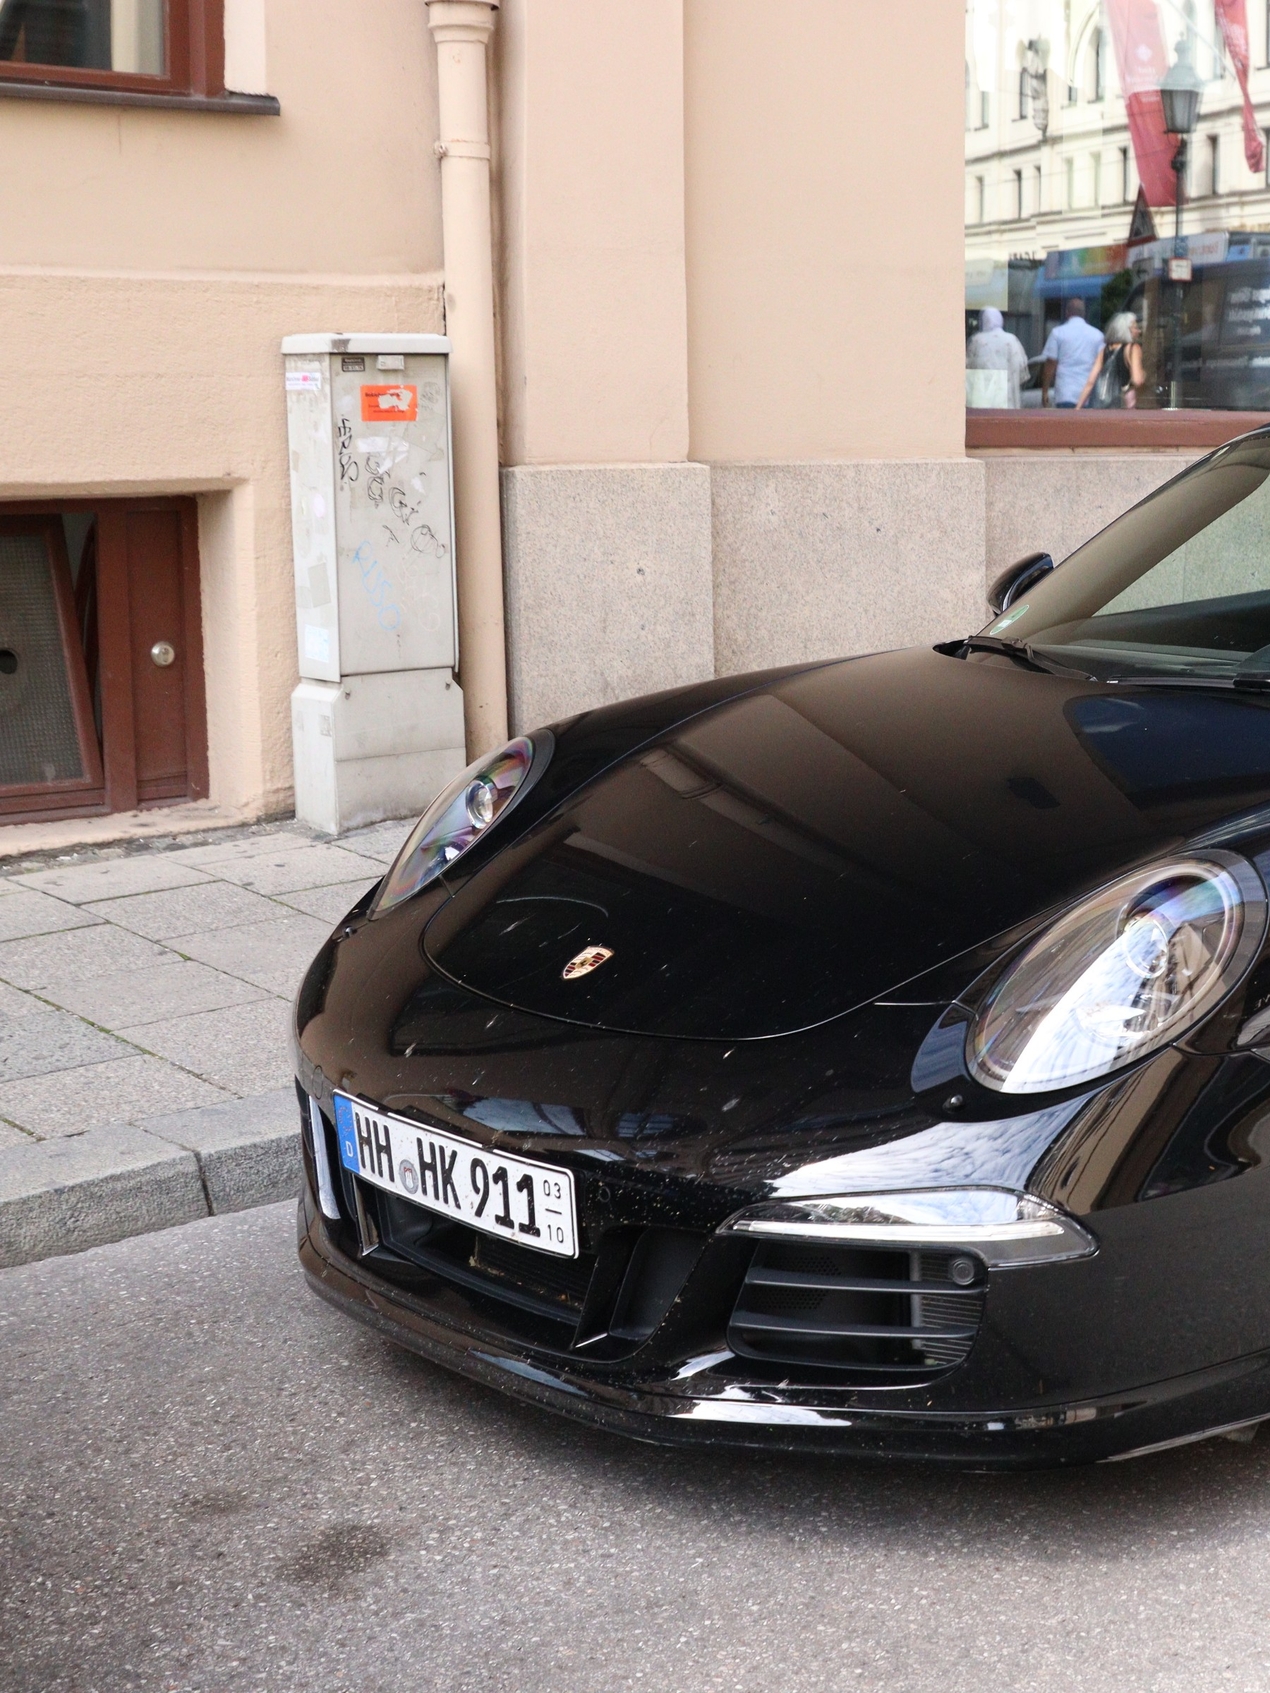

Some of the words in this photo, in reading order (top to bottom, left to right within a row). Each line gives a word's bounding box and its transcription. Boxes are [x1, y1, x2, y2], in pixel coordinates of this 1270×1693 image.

[345, 1141, 354, 1158] D
[355, 1112, 396, 1183] HH
[416, 1137, 462, 1210] HK
[470, 1157, 541, 1238] 911
[543, 1179, 562, 1200] 03
[547, 1224, 564, 1244] 10
